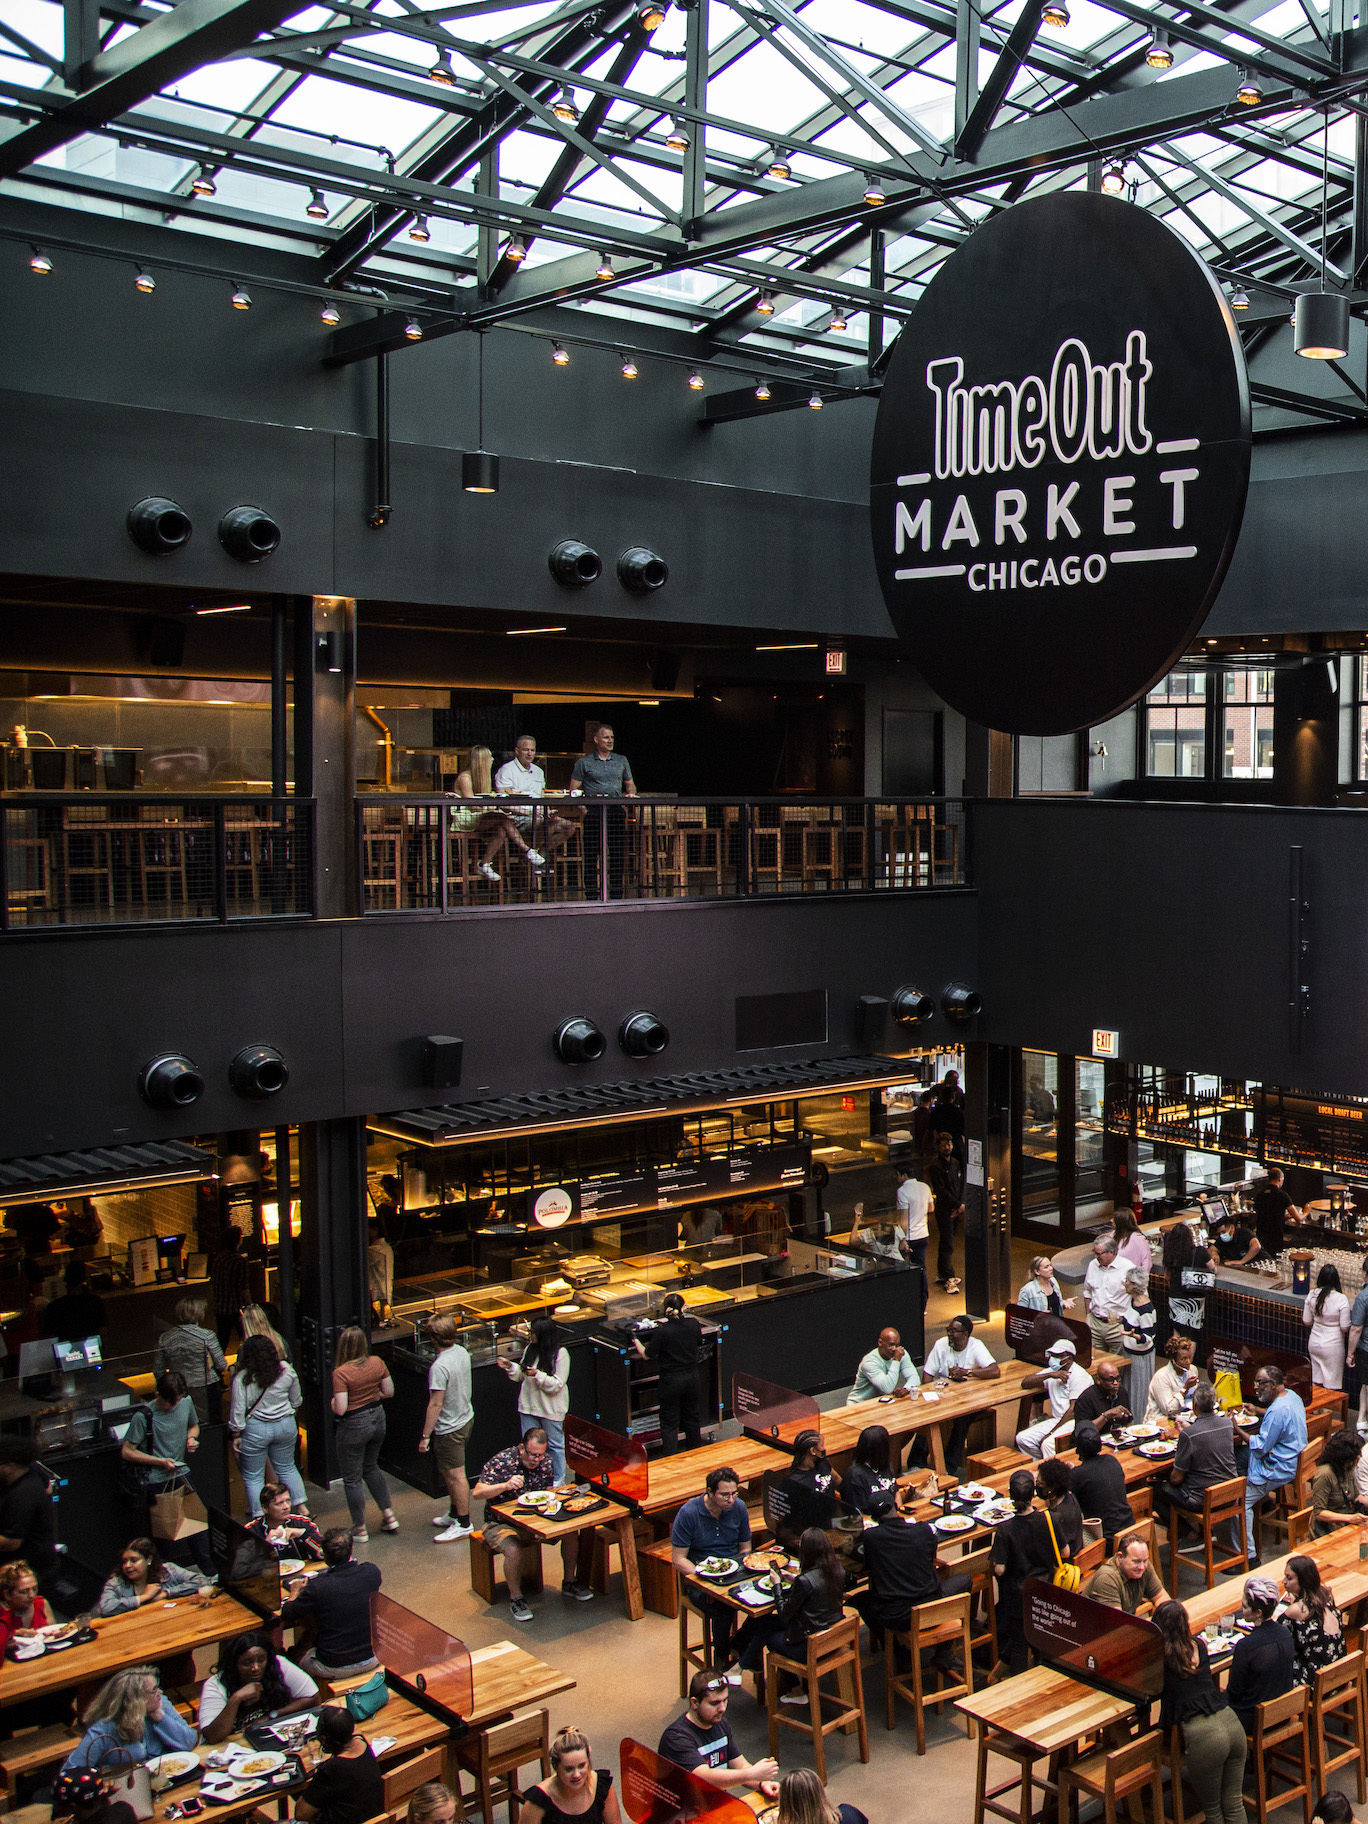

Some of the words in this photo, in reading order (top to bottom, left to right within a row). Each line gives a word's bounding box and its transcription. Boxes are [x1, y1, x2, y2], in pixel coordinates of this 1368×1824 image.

[895, 468, 1200, 554] MARKET
[968, 554, 1107, 592] CHICAGO
[829, 653, 840, 666] EXIT
[1097, 1032, 1111, 1048] EXIT
[1318, 1106, 1334, 1116] LOCAL
[1334, 1108, 1350, 1118] DRAFT
[1350, 1110, 1364, 1120] BEER
[1031, 1606, 1041, 1614] was
[1050, 1613, 1063, 1624] going
[1063, 1618, 1071, 1626] out
[1031, 1614, 1040, 1622] the
[1053, 1604, 1071, 1618] Chicago
